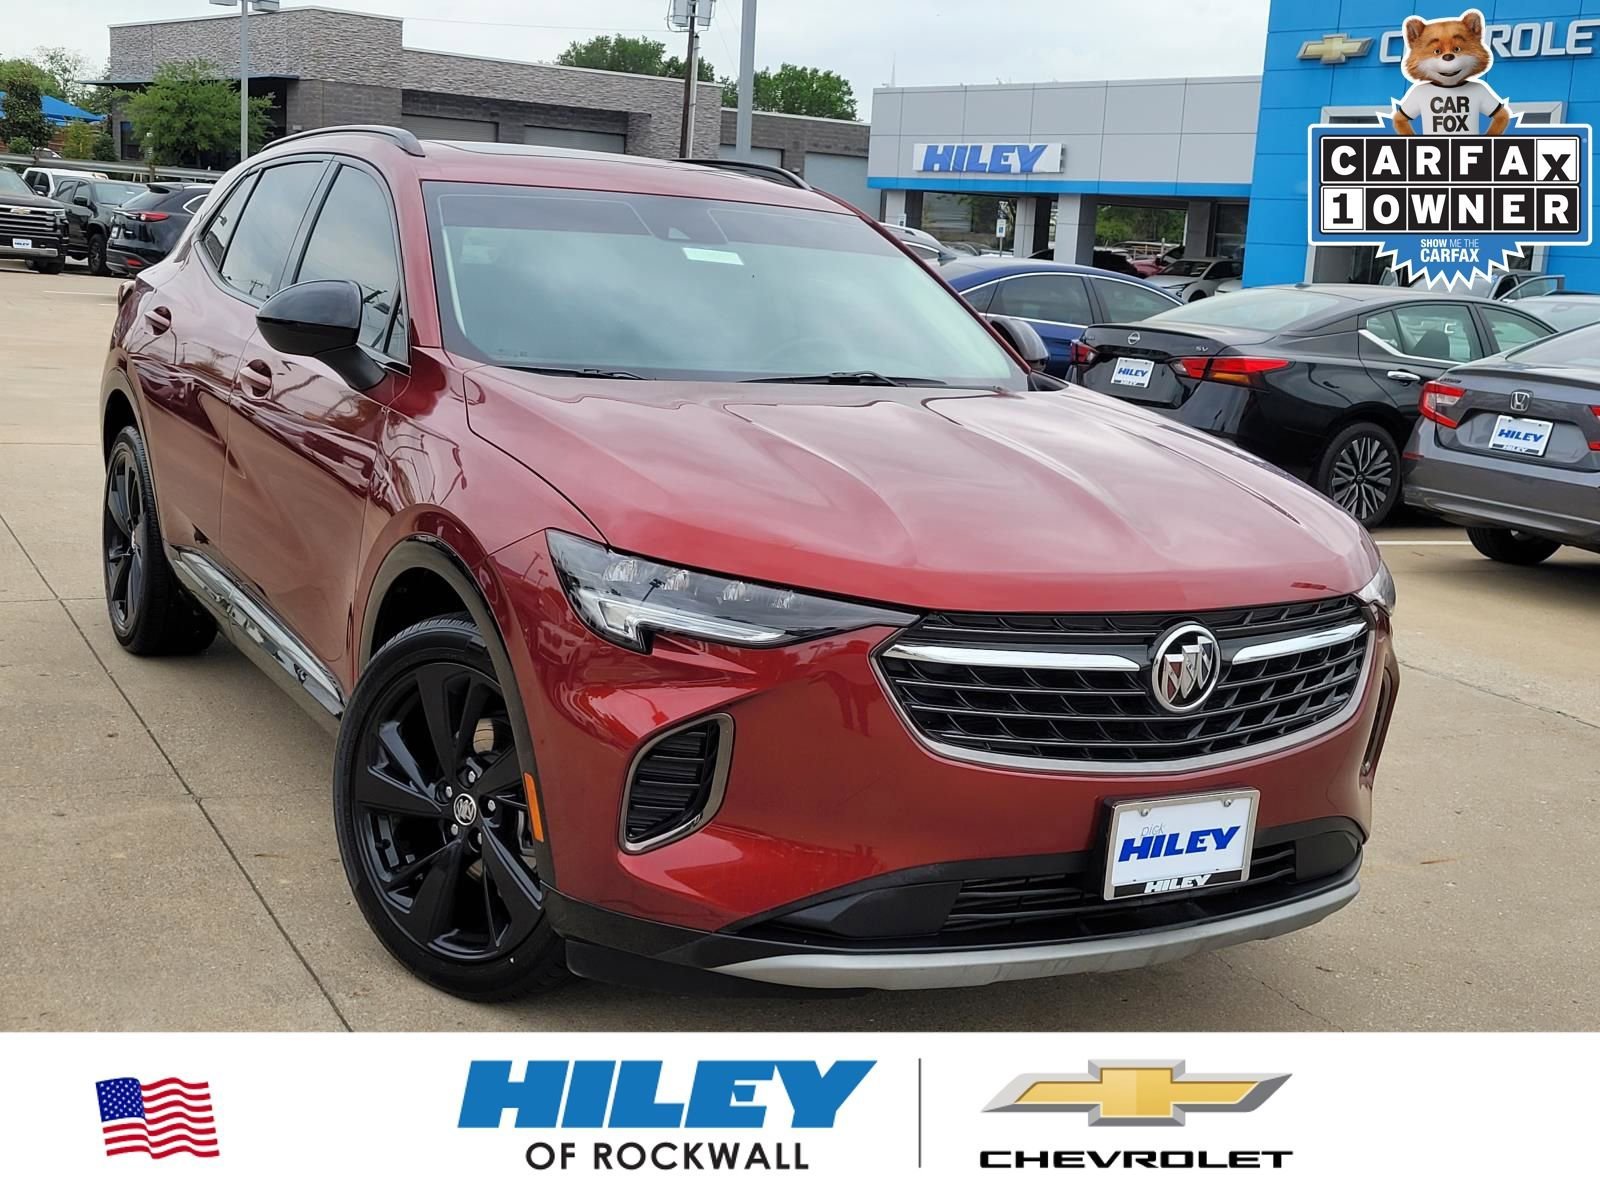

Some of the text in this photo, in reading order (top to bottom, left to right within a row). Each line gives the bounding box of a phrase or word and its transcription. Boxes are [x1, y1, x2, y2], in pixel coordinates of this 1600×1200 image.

[922, 144, 1048, 173] HILEY
[1118, 367, 1149, 378] HILEY
[1498, 428, 1544, 443] HILEY
[1118, 826, 1241, 863] HILEY
[1144, 873, 1212, 894] HILEY
